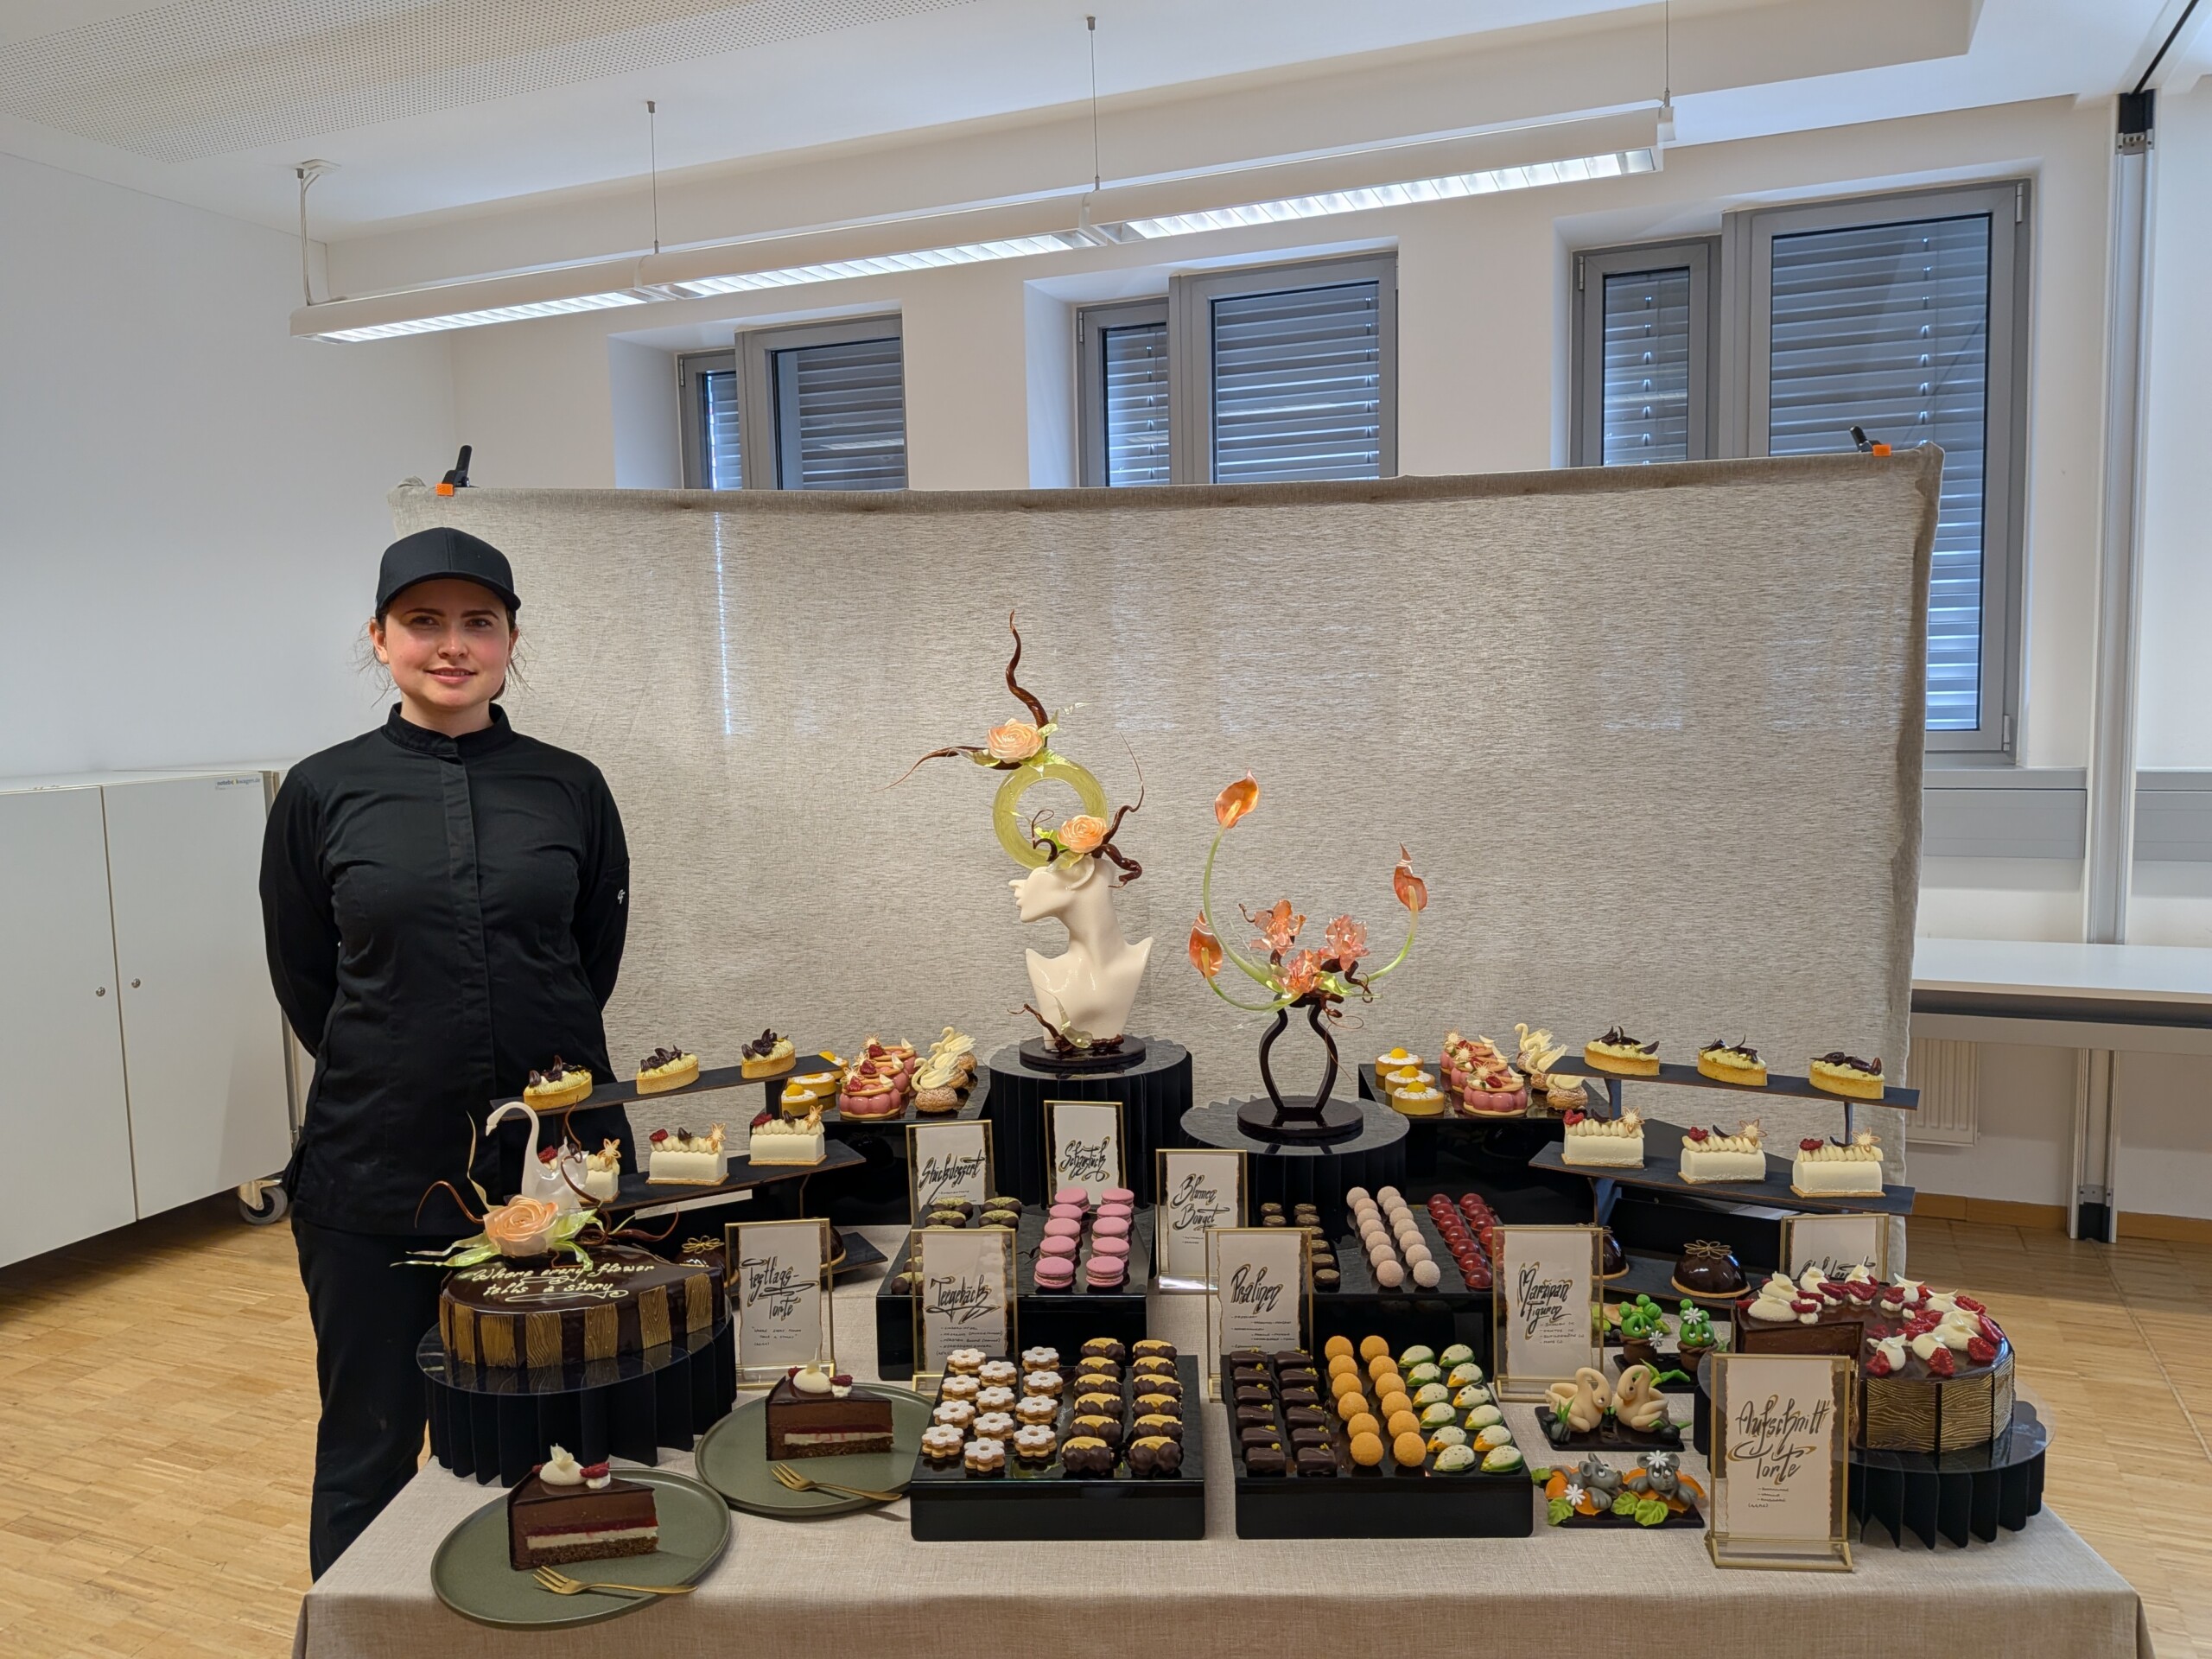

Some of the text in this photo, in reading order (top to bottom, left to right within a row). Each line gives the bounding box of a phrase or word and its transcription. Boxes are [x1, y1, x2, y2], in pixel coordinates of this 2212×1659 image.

[1171, 1173, 1217, 1208] Blumen
[472, 1268, 534, 1281] Where
[588, 1262, 655, 1278] flower
[483, 1281, 529, 1296] tells
[563, 1279, 614, 1298] story
[1230, 1264, 1284, 1313] Pralinen
[1518, 1262, 1573, 1317] Marzipan
[926, 1274, 999, 1322] Teegebäck
[1735, 1395, 1830, 1453] Aufschnitt
[1732, 1441, 1811, 1484] Torte
